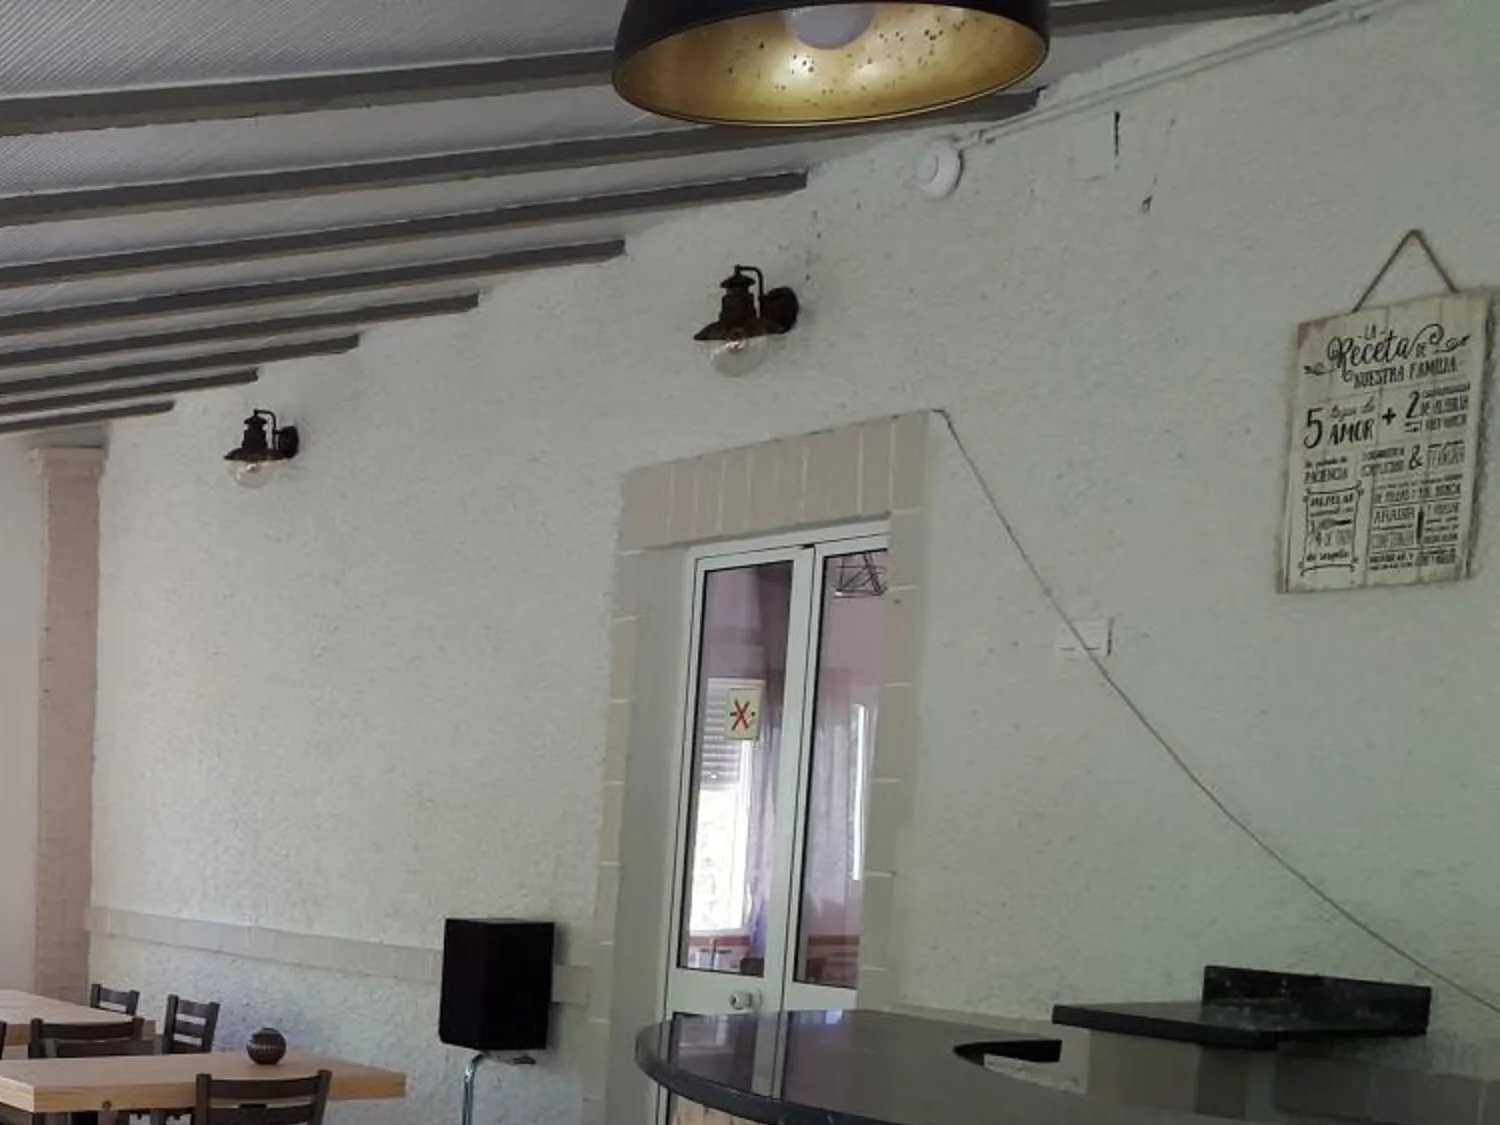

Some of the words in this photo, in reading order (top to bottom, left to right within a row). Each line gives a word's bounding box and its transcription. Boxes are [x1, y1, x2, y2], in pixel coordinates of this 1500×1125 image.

[1328, 328, 1410, 382] Receta
[1354, 365, 1405, 389] NUESTRA
[1409, 356, 1458, 380] FAMILIA
[1406, 391, 1421, 419] 2
[1303, 407, 1324, 449] 5
[1328, 418, 1376, 446] AMOR
